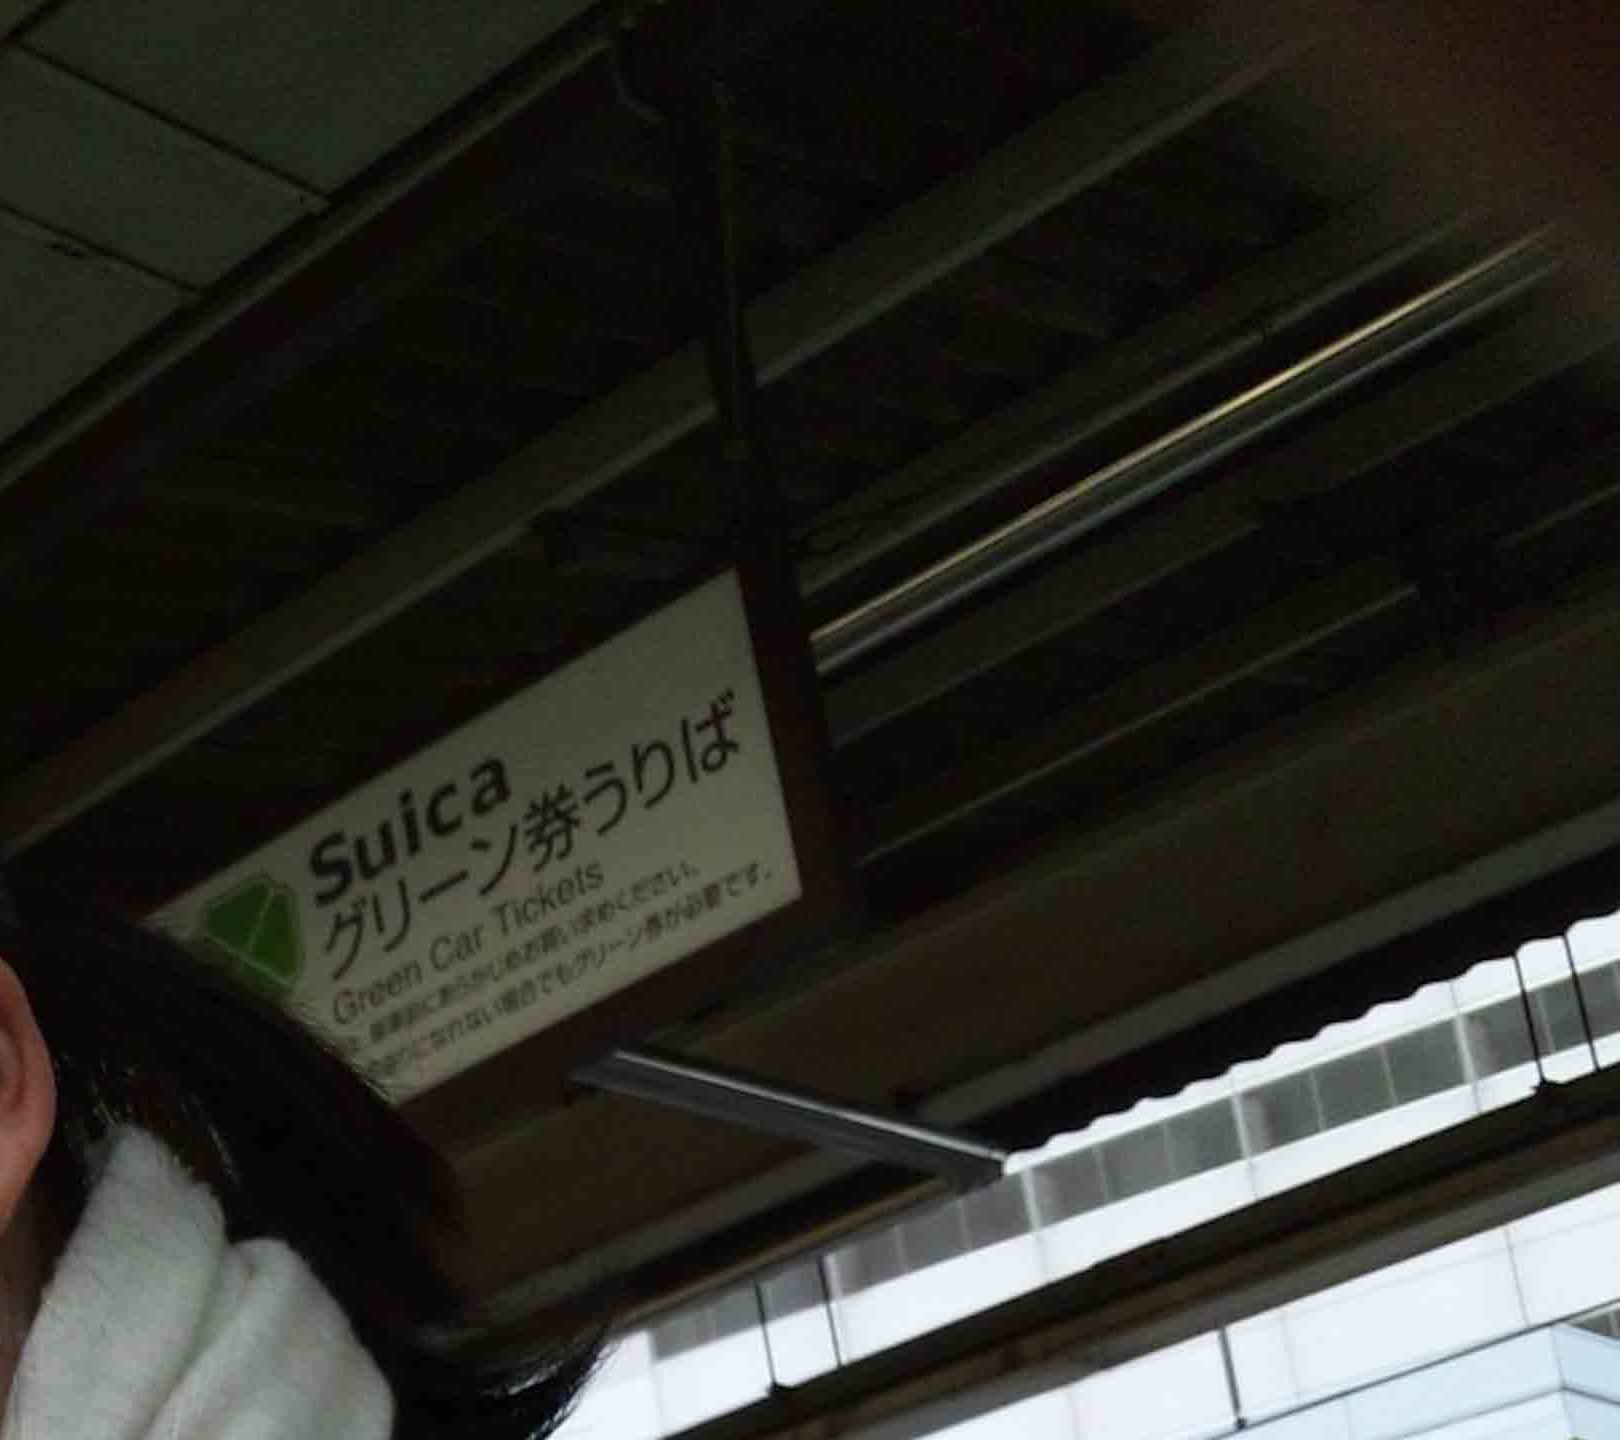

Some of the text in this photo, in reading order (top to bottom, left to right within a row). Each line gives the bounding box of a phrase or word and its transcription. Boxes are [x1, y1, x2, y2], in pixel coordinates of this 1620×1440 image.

[309, 757, 511, 908] Suica
[324, 688, 741, 981] グリーン券うりば
[331, 860, 606, 1026] Green Car Tickets
